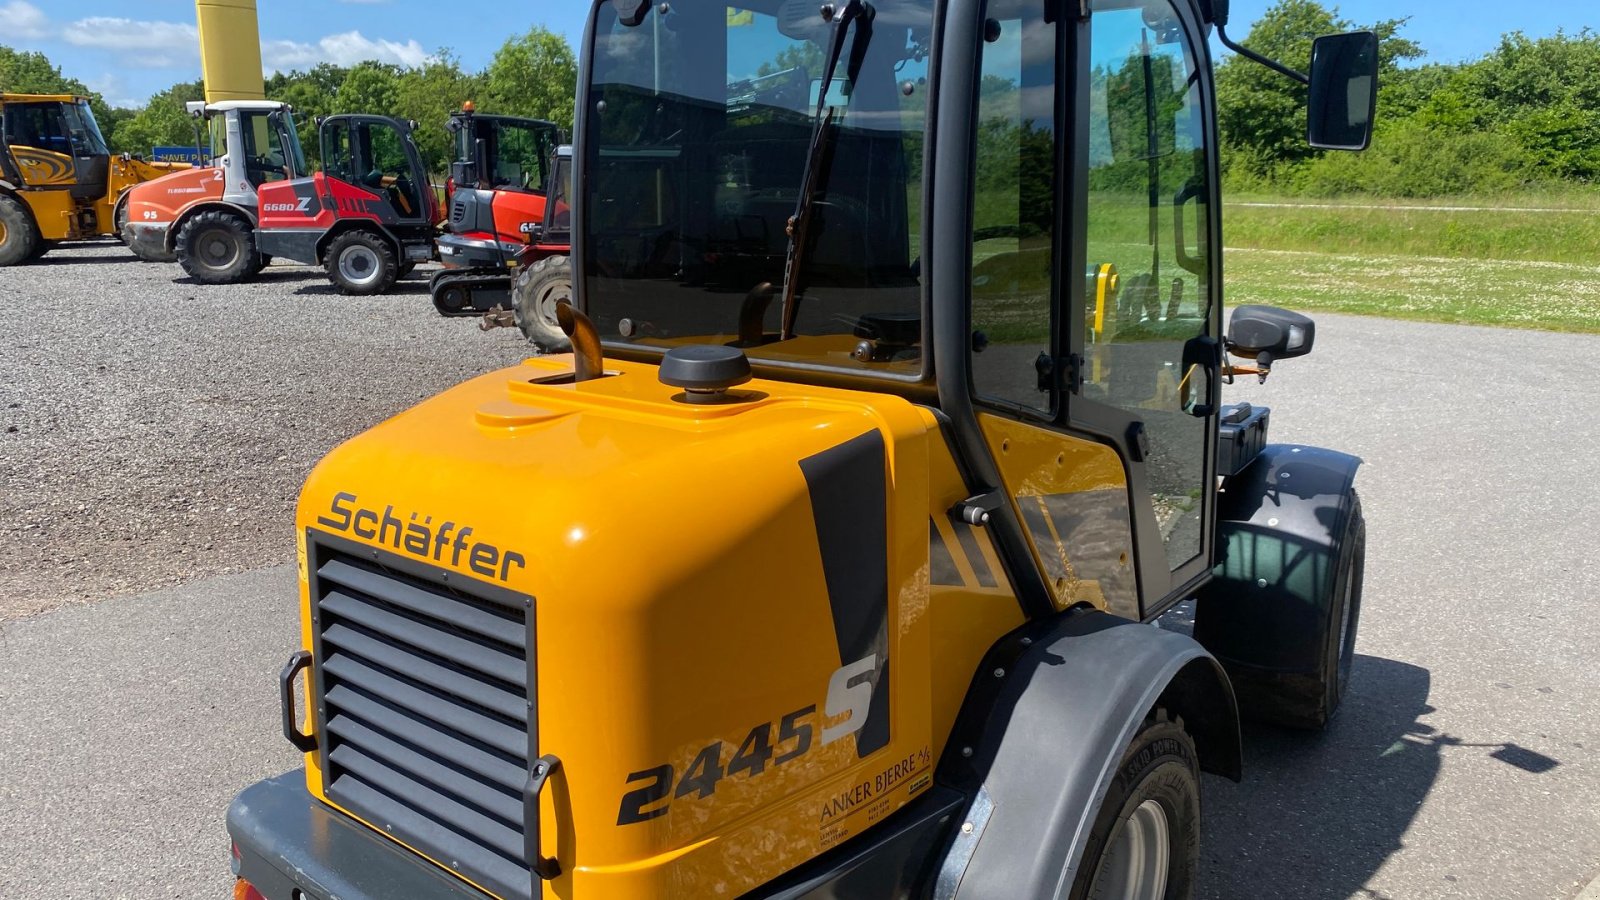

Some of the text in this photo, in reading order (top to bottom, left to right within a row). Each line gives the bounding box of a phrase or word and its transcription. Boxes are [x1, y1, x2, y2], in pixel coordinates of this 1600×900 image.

[143, 211, 157, 219] 95
[263, 203, 294, 211] 6680
[317, 491, 525, 582] Schäffer
[616, 704, 817, 827] 2445
[820, 781, 872, 822] ANKER
[875, 754, 916, 792] BJERRE
